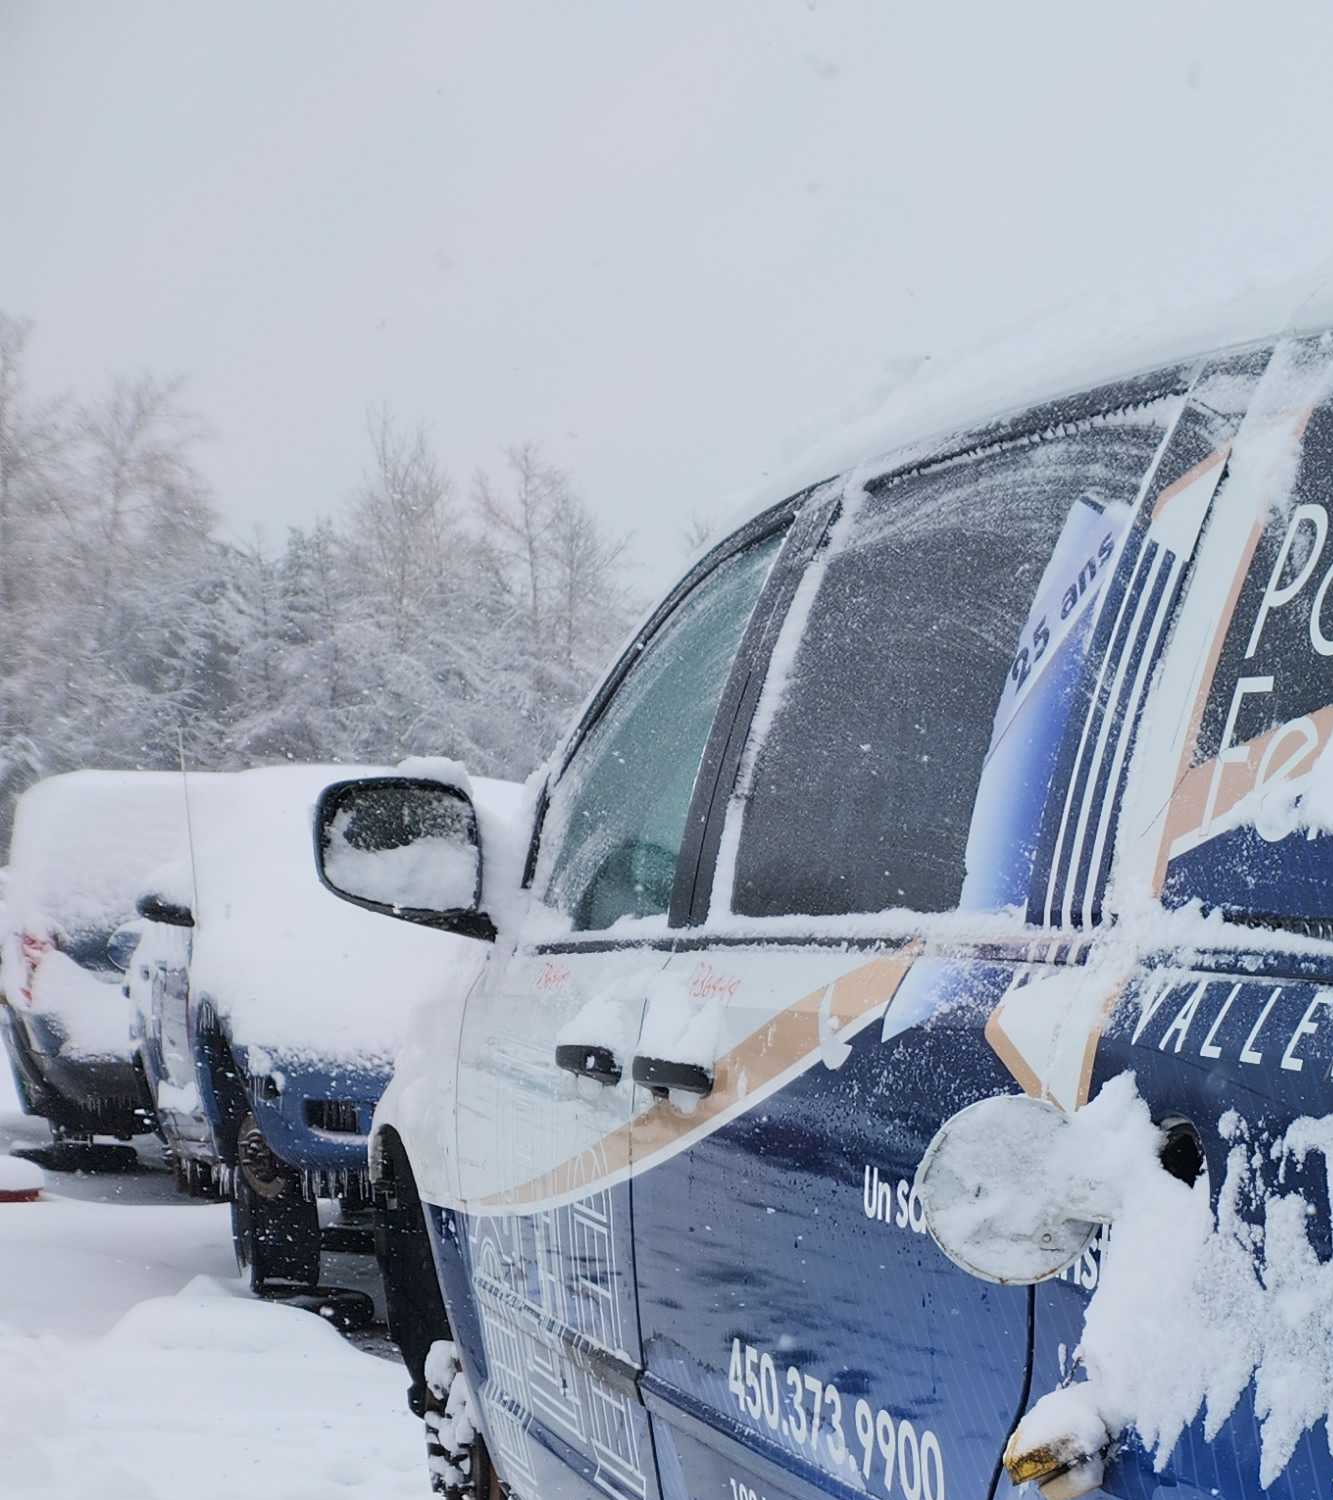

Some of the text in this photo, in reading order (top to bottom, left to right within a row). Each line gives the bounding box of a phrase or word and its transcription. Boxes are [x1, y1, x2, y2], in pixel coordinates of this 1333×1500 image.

[1010, 531, 1115, 695] 25 ans
[864, 1164, 891, 1224] Un
